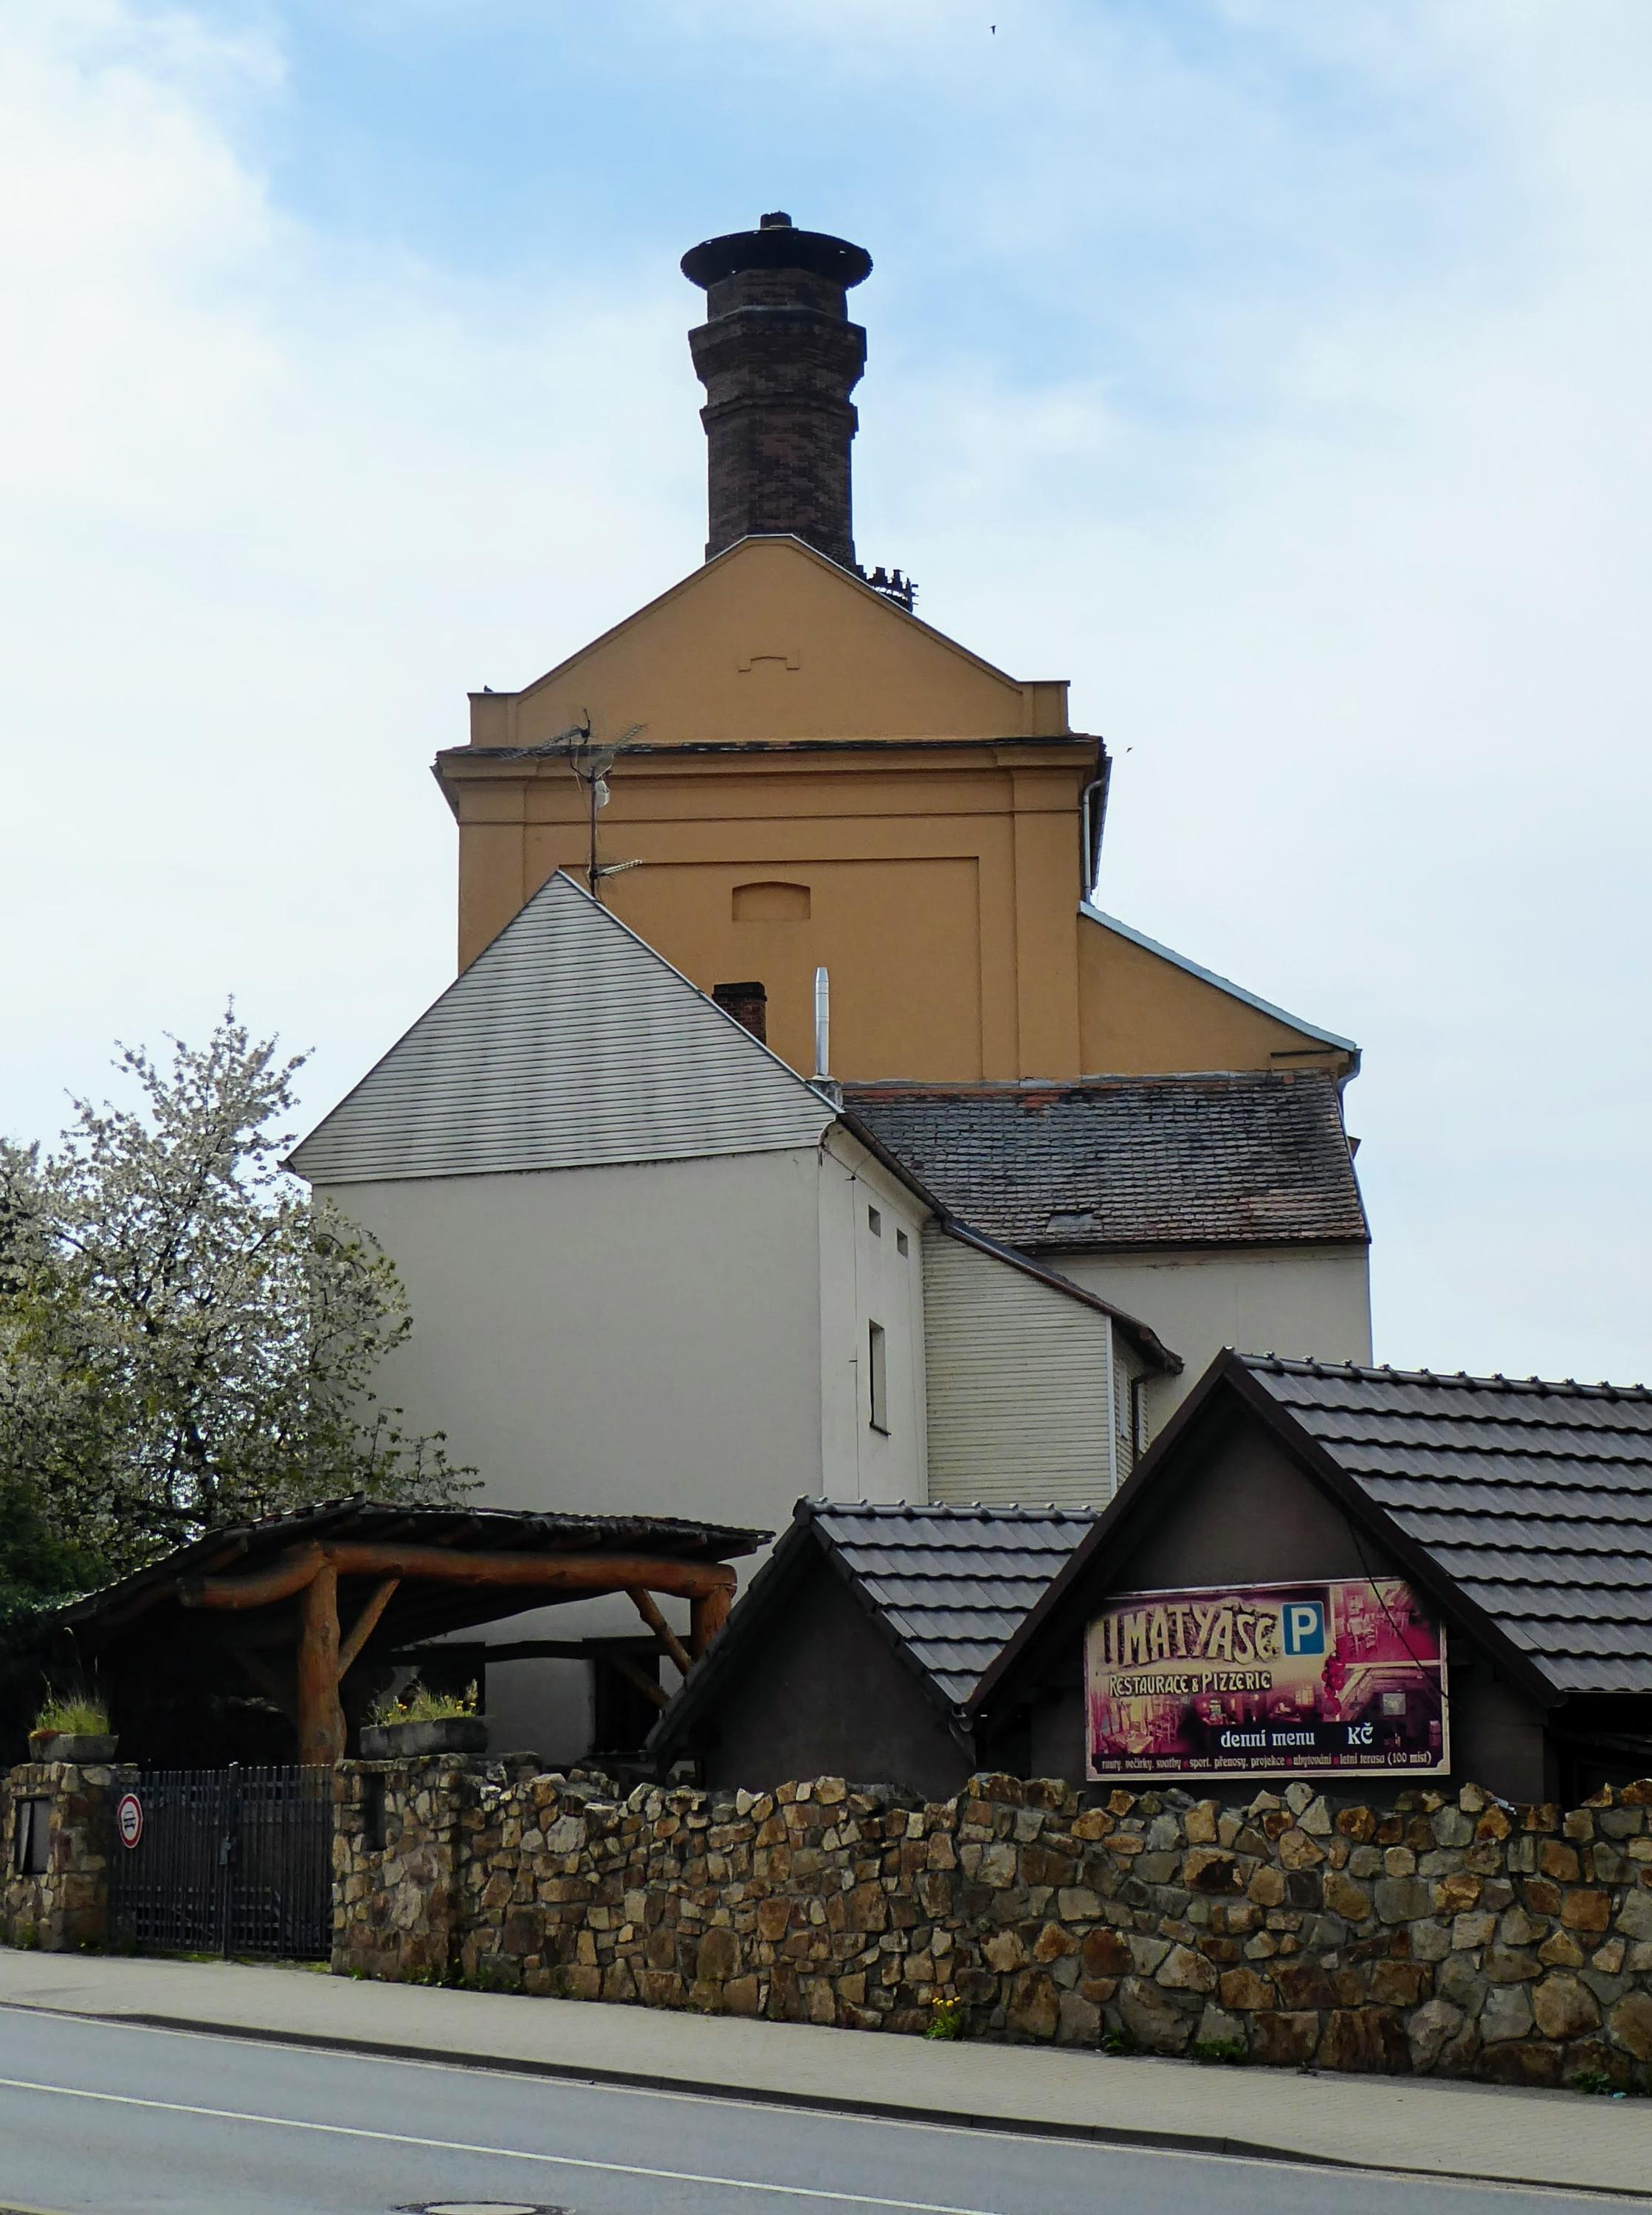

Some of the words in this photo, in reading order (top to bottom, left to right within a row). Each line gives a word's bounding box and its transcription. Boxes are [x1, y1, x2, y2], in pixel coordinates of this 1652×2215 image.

[1291, 1607, 1318, 1652] P
[1109, 1674, 1189, 1697] RESTAURACE
[1192, 1677, 1200, 1693] &
[1202, 1671, 1271, 1693] PIZZERIE
[1220, 1729, 1267, 1748] denní
[1271, 1732, 1315, 1746] menu
[1250, 1754, 1285, 1768] projekce
[1360, 1754, 1386, 1764] terasa
[1388, 1751, 1408, 1766] (100
